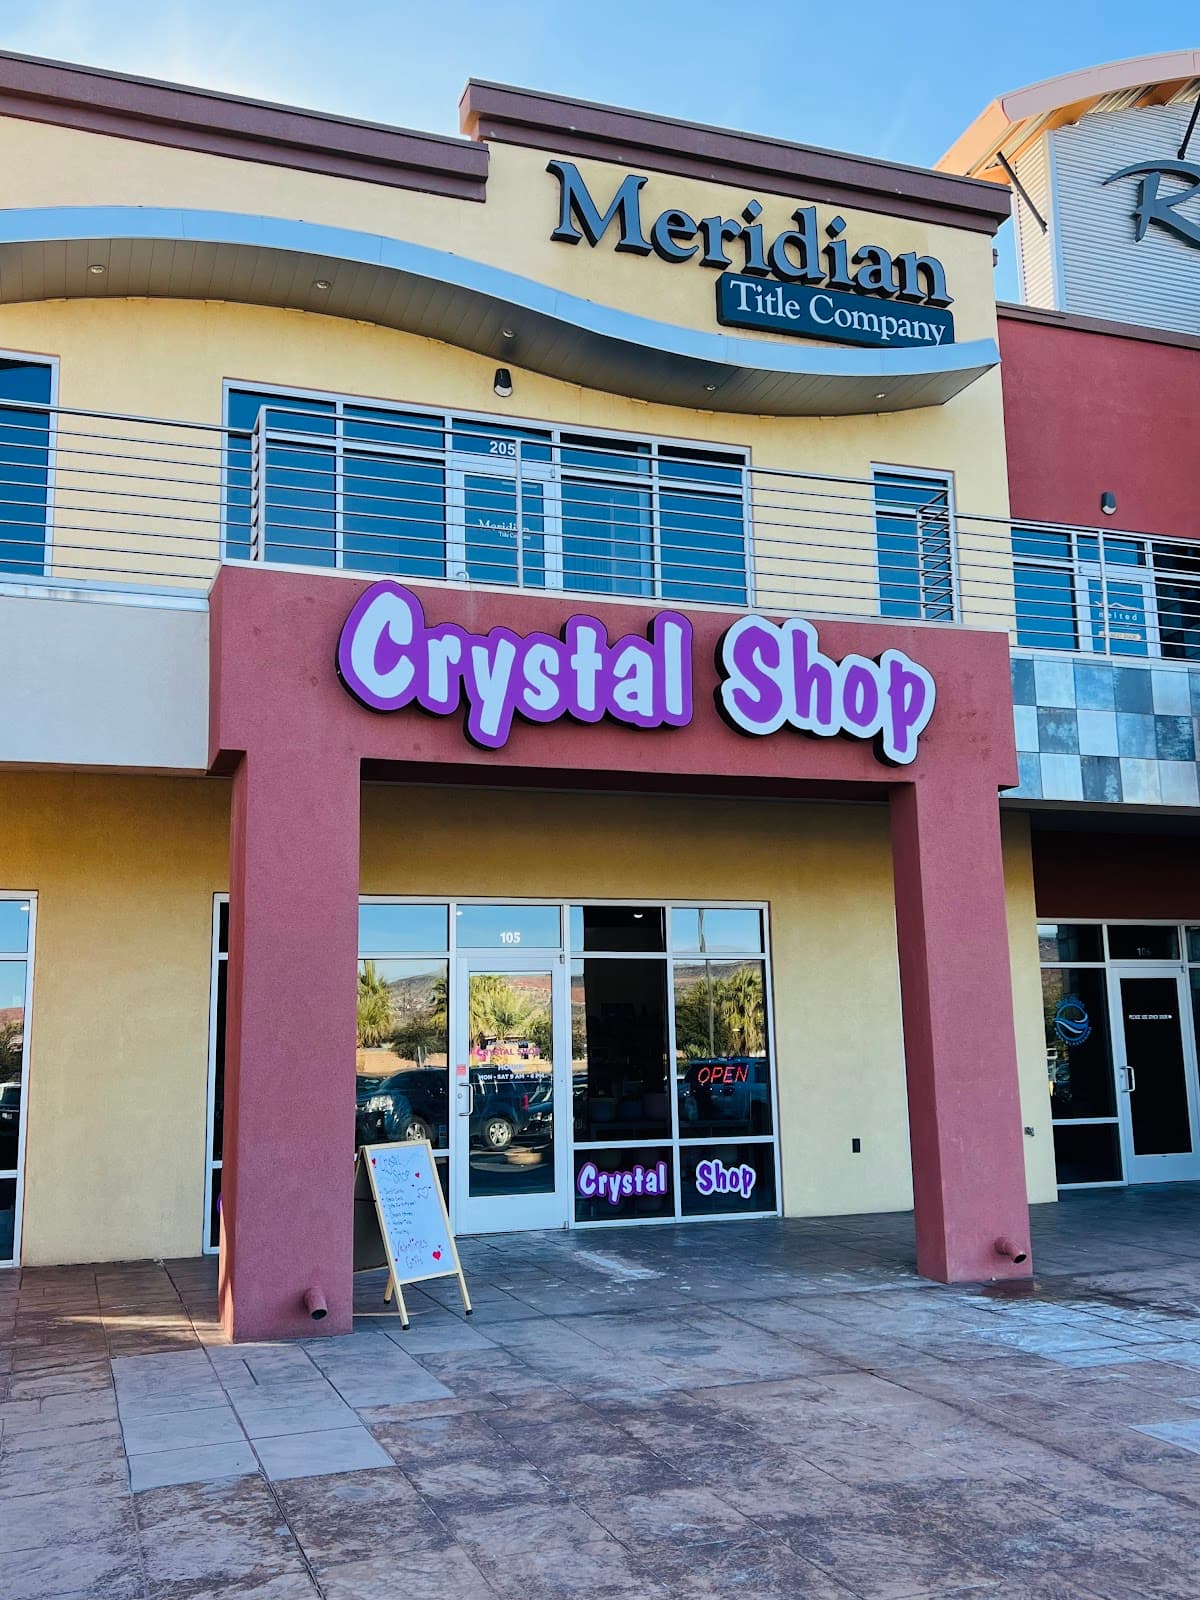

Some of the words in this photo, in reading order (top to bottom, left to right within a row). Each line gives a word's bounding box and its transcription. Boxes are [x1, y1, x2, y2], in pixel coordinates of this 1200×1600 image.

[545, 160, 955, 307] Meridian
[729, 279, 801, 320] Title
[808, 293, 947, 346] Company
[489, 440, 516, 456] 205
[338, 581, 693, 748] Crystal
[721, 615, 936, 763] Shop
[500, 932, 521, 944] 105
[697, 1065, 749, 1083] OPEN
[578, 1161, 668, 1205] Crystal
[696, 1159, 756, 1198] Shop
